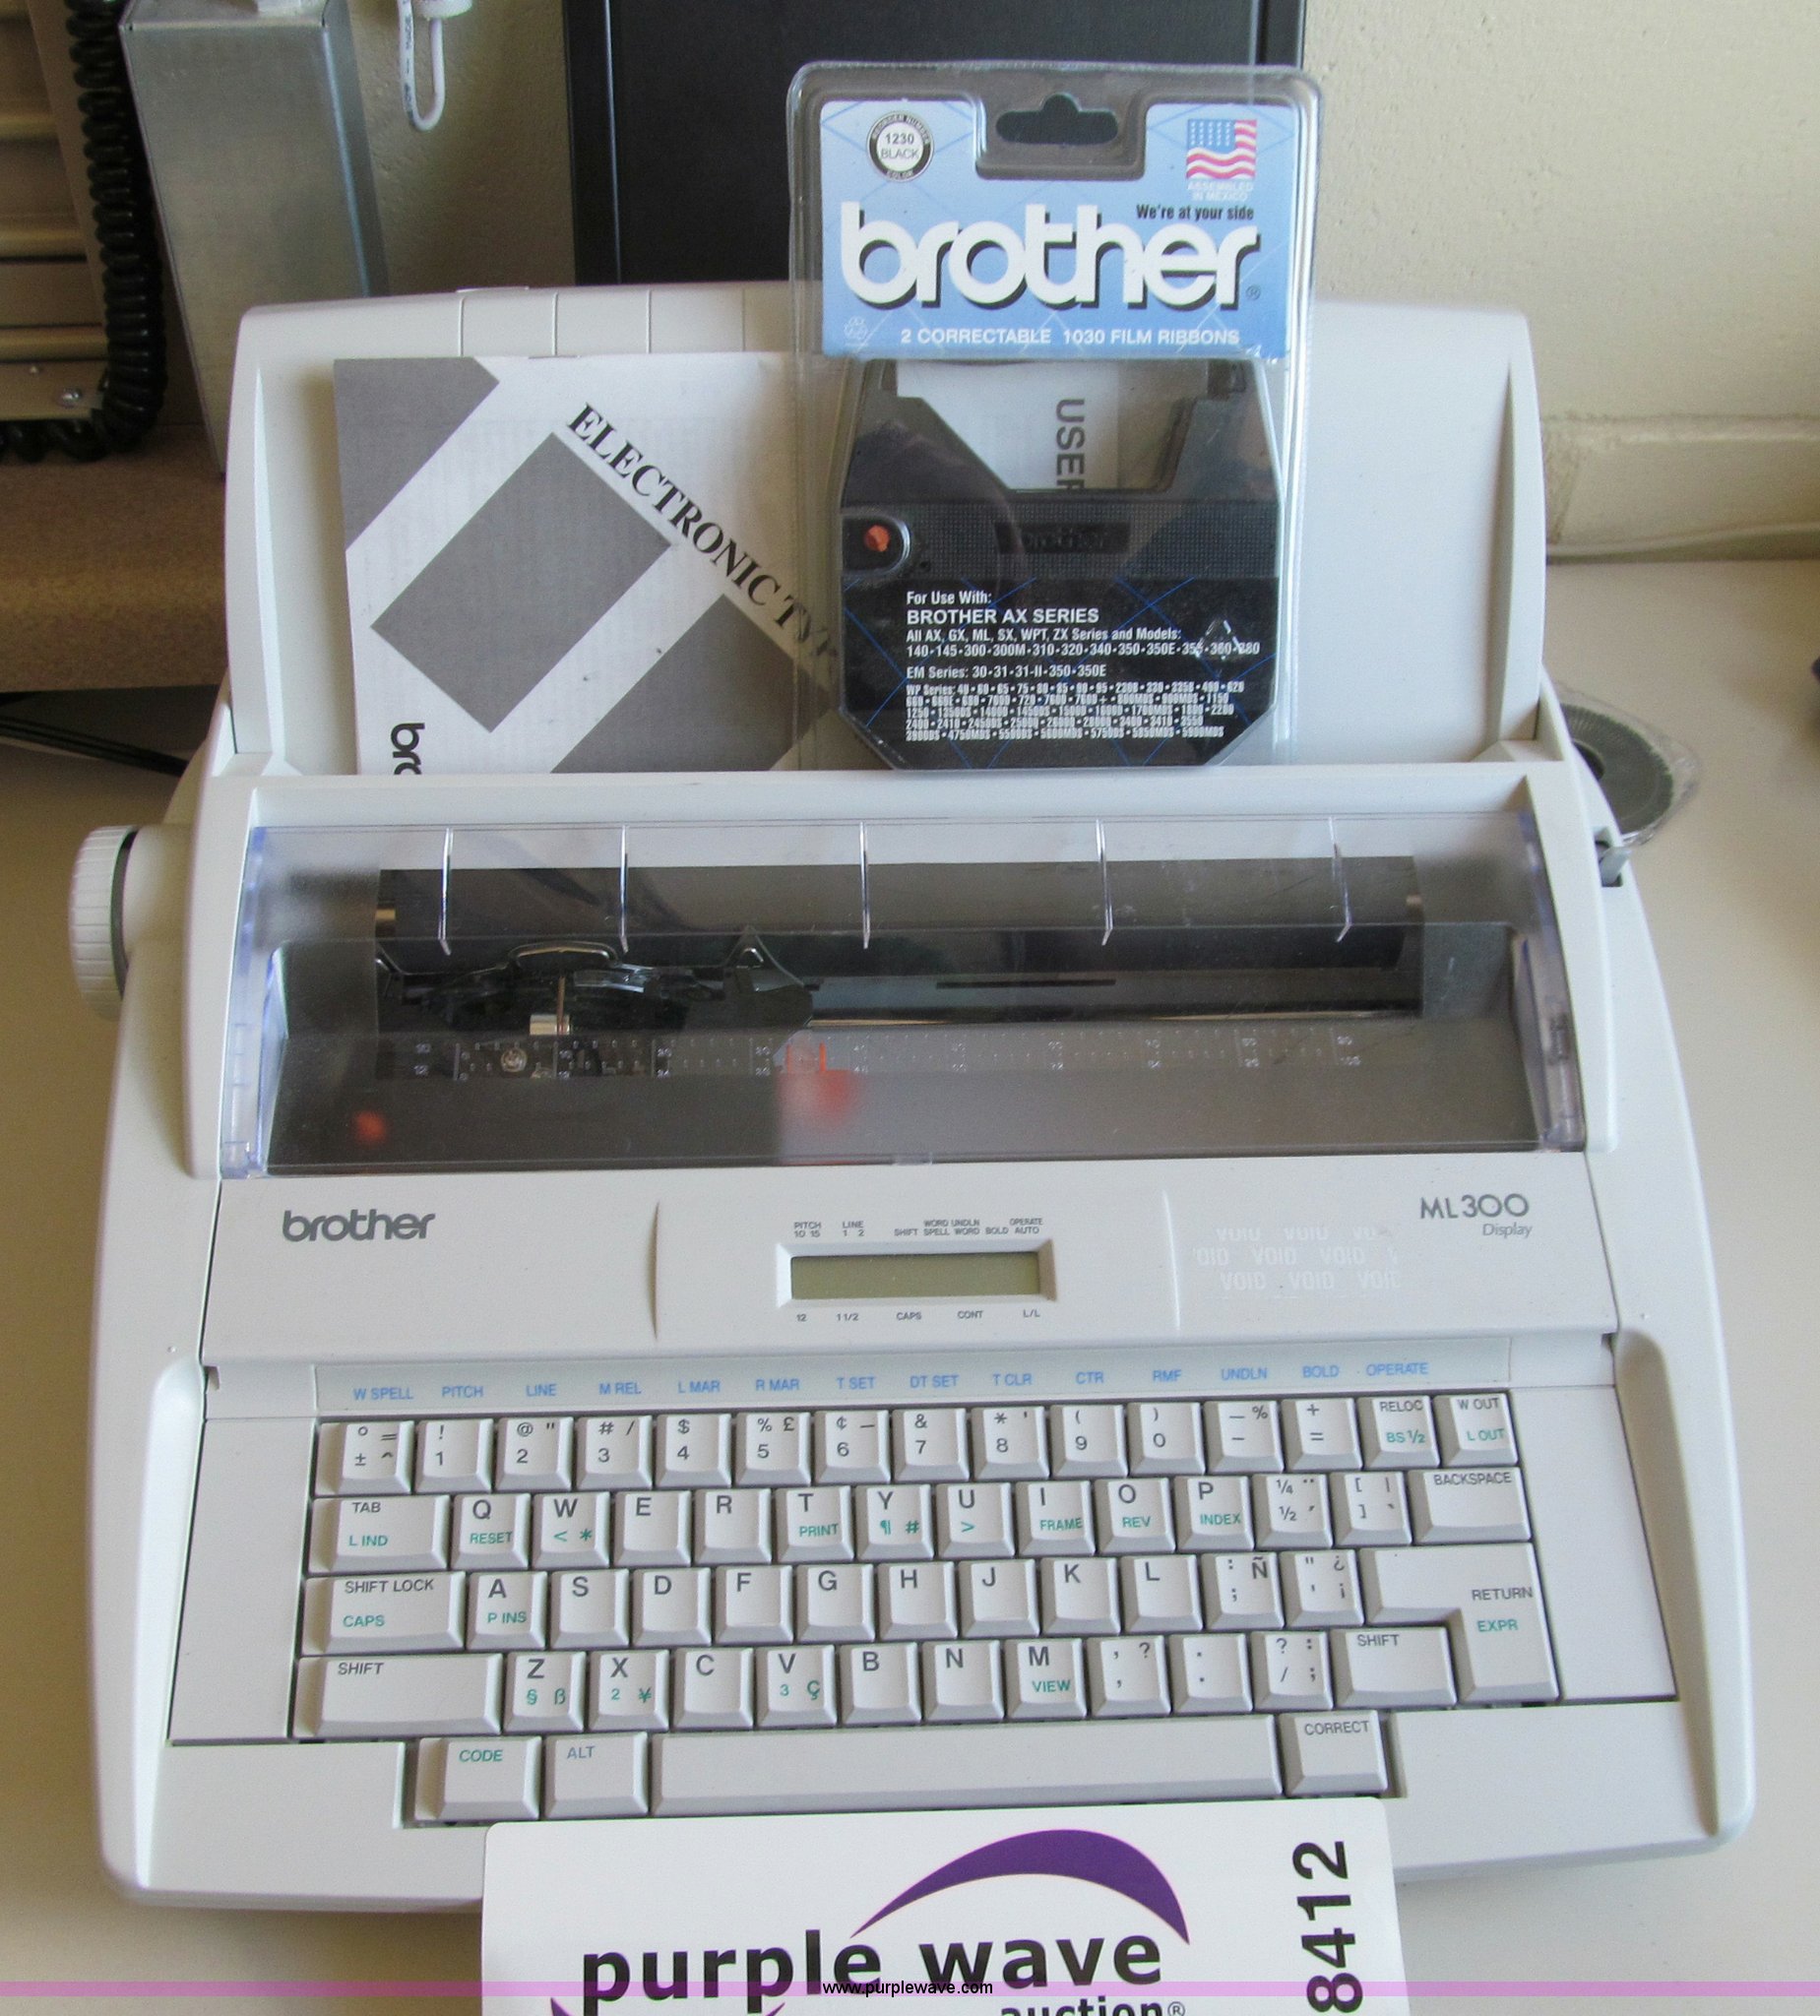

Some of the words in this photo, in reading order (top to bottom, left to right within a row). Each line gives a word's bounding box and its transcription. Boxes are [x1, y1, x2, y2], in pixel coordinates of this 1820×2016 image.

[885, 133, 914, 145] 1230
[881, 148, 919, 158] BLACK
[1136, 204, 1174, 219] We're
[1179, 206, 1191, 219] at
[1195, 206, 1223, 221] your
[1226, 205, 1254, 220] side
[841, 201, 1261, 311] brother
[901, 330, 911, 344] 2
[917, 329, 1051, 345] CORRECTABLE
[1064, 329, 1105, 345] 1030
[1110, 329, 1153, 345] FILM
[1158, 329, 1240, 346] RIBBONS
[566, 402, 781, 607] ELECTRONIC
[907, 591, 927, 604] For
[931, 591, 955, 604] Use
[959, 591, 992, 604] With:
[907, 609, 997, 625] BROTHER
[1002, 608, 1028, 624] AX
[1033, 607, 1099, 623] SERIES
[907, 630, 922, 642] All
[925, 630, 945, 643] AX,
[949, 629, 969, 643] GX,
[973, 629, 993, 643] ML,
[997, 629, 1018, 643] SX,
[1021, 628, 1049, 643] WPT,
[1053, 628, 1068, 642] ZX
[1072, 627, 1108, 641] Series
[1112, 627, 1132, 640] and
[1136, 627, 1182, 641] Models:
[907, 665, 925, 679] EM
[928, 665, 970, 679] Series:
[282, 1209, 436, 1242] brother
[794, 1221, 822, 1229] PITCH
[1010, 1217, 1043, 1227] OPERATE
[794, 1229, 806, 1238] 10
[923, 1228, 950, 1236] SPELL
[985, 1227, 1009, 1235] BOLD
[1015, 1226, 1039, 1234] AUTO
[1482, 1223, 1533, 1239] Display
[1194, 1247, 1229, 1266] OID
[796, 1313, 807, 1322] 12
[896, 1310, 922, 1320] CAPS
[957, 1310, 983, 1319] CONT
[1023, 1308, 1040, 1318] L/L
[1153, 1370, 1181, 1382] RMF
[1222, 1367, 1268, 1380] UNDLN
[1302, 1365, 1340, 1378] BOLD
[1366, 1362, 1429, 1376] OPERATE
[756, 1380, 766, 1391] R
[769, 1379, 799, 1391] MAR
[849, 1377, 876, 1389] SET
[910, 1376, 927, 1388] DT
[931, 1375, 959, 1387] SET
[1005, 1373, 1032, 1385] CLR
[1076, 1372, 1104, 1384] CTR
[353, 1389, 366, 1399] W
[371, 1387, 414, 1400] SPELL
[442, 1386, 484, 1398] PITCH
[526, 1384, 557, 1397] LINE
[599, 1383, 611, 1394] M
[615, 1382, 642, 1394] REL
[690, 1381, 721, 1392] MAR
[1380, 1400, 1424, 1413] RELOC
[1458, 1400, 1471, 1411] W
[1474, 1398, 1500, 1410] OUT
[1386, 1432, 1406, 1443] BS
[1478, 1428, 1505, 1441] OUT
[837, 1442, 849, 1457] 6
[915, 1440, 927, 1455] 7
[996, 1438, 1009, 1453] 8
[1075, 1436, 1088, 1451] 9
[434, 1451, 444, 1466] 1
[516, 1449, 529, 1464] 2
[597, 1448, 610, 1463] 3
[677, 1445, 689, 1461] 4
[757, 1444, 770, 1459] 5
[1433, 1472, 1512, 1486] BACKSPACE
[1039, 1487, 1045, 1506] I
[1118, 1484, 1137, 1503] O
[1198, 1481, 1214, 1500] P
[716, 1495, 733, 1514] R
[797, 1493, 814, 1513] T
[877, 1491, 894, 1510] Y
[958, 1489, 975, 1508] U
[352, 1501, 382, 1514] TAB
[472, 1499, 492, 1520] Q
[553, 1498, 579, 1518] W
[635, 1497, 653, 1517] E
[1039, 1519, 1083, 1532] FRAME
[1122, 1516, 1152, 1528] REV
[1200, 1513, 1241, 1525] INDEX
[470, 1532, 512, 1544] RESET
[798, 1524, 839, 1537] PRINT
[361, 1535, 388, 1546] IND
[1063, 1563, 1081, 1583] K
[1145, 1561, 1161, 1581] L
[1251, 1555, 1268, 1579] Ñ
[736, 1572, 752, 1592] F
[818, 1571, 838, 1591] G
[901, 1569, 918, 1588] H
[981, 1567, 996, 1587] J
[345, 1580, 389, 1594] SHIFT
[393, 1579, 434, 1592] LOCK
[488, 1578, 508, 1599] A
[572, 1576, 590, 1598] S
[654, 1575, 672, 1595] D
[1472, 1586, 1534, 1601] RETURN
[343, 1614, 385, 1627] CAPS
[487, 1612, 497, 1623] P
[501, 1610, 527, 1623] INS
[1477, 1618, 1519, 1632] EXPR
[1357, 1634, 1400, 1647] SHIFT
[778, 1653, 796, 1673] V
[862, 1651, 880, 1671] B
[946, 1648, 964, 1668] N
[1029, 1646, 1049, 1666] M
[338, 1662, 384, 1675] SHIFT
[527, 1659, 544, 1678] Z
[609, 1658, 629, 1678] X
[695, 1654, 716, 1675] C
[806, 1679, 820, 1700] Ç
[1033, 1679, 1071, 1692] VIEW
[1304, 1721, 1370, 1735] CORRECT
[459, 1749, 503, 1762] CODE
[567, 1746, 596, 1759] ALT
[1292, 1840, 1364, 2014] 8412
[583, 1928, 882, 2016] purple
[918, 1932, 1161, 1988] wave
